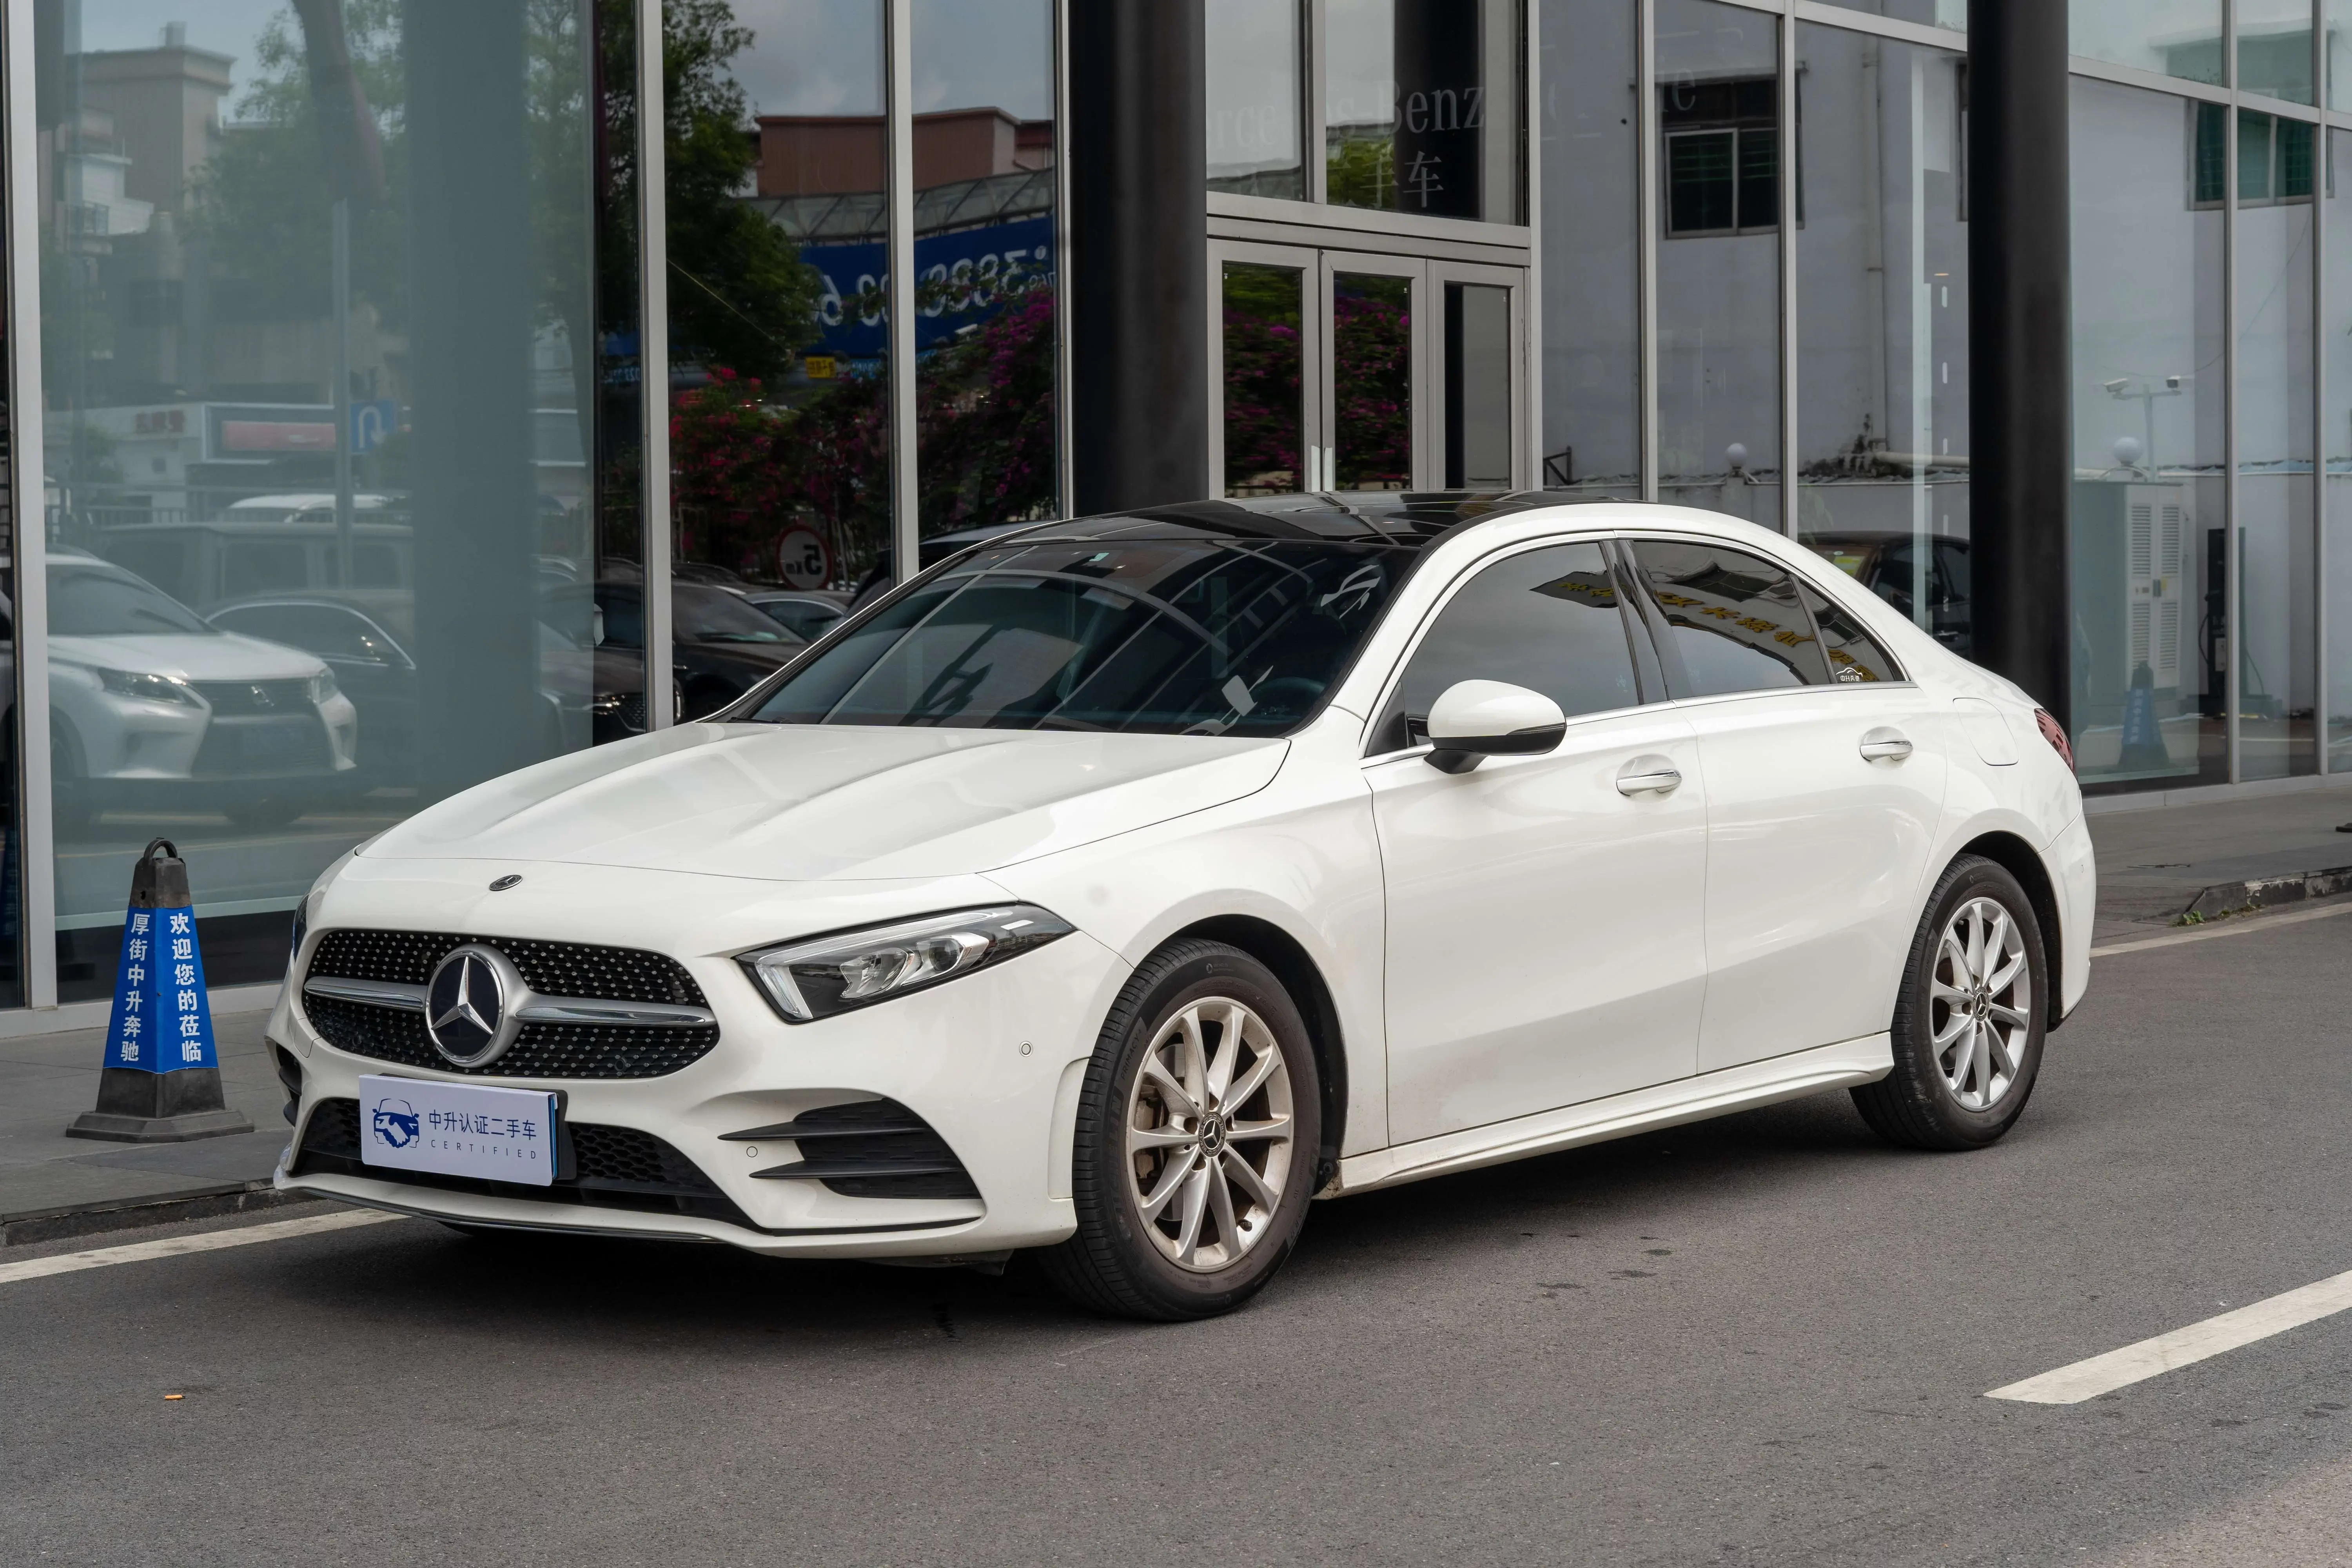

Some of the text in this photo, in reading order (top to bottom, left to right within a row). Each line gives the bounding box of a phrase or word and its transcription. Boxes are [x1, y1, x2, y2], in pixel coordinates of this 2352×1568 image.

[121, 913, 150, 1061] 厚街中升奔驰
[170, 913, 201, 1062] 欢迎您的莅临
[1120, 1034, 1141, 1081] PRIMACY
[428, 1109, 537, 1140] 中升认证二手车
[431, 1140, 536, 1159] CERTIFIED
